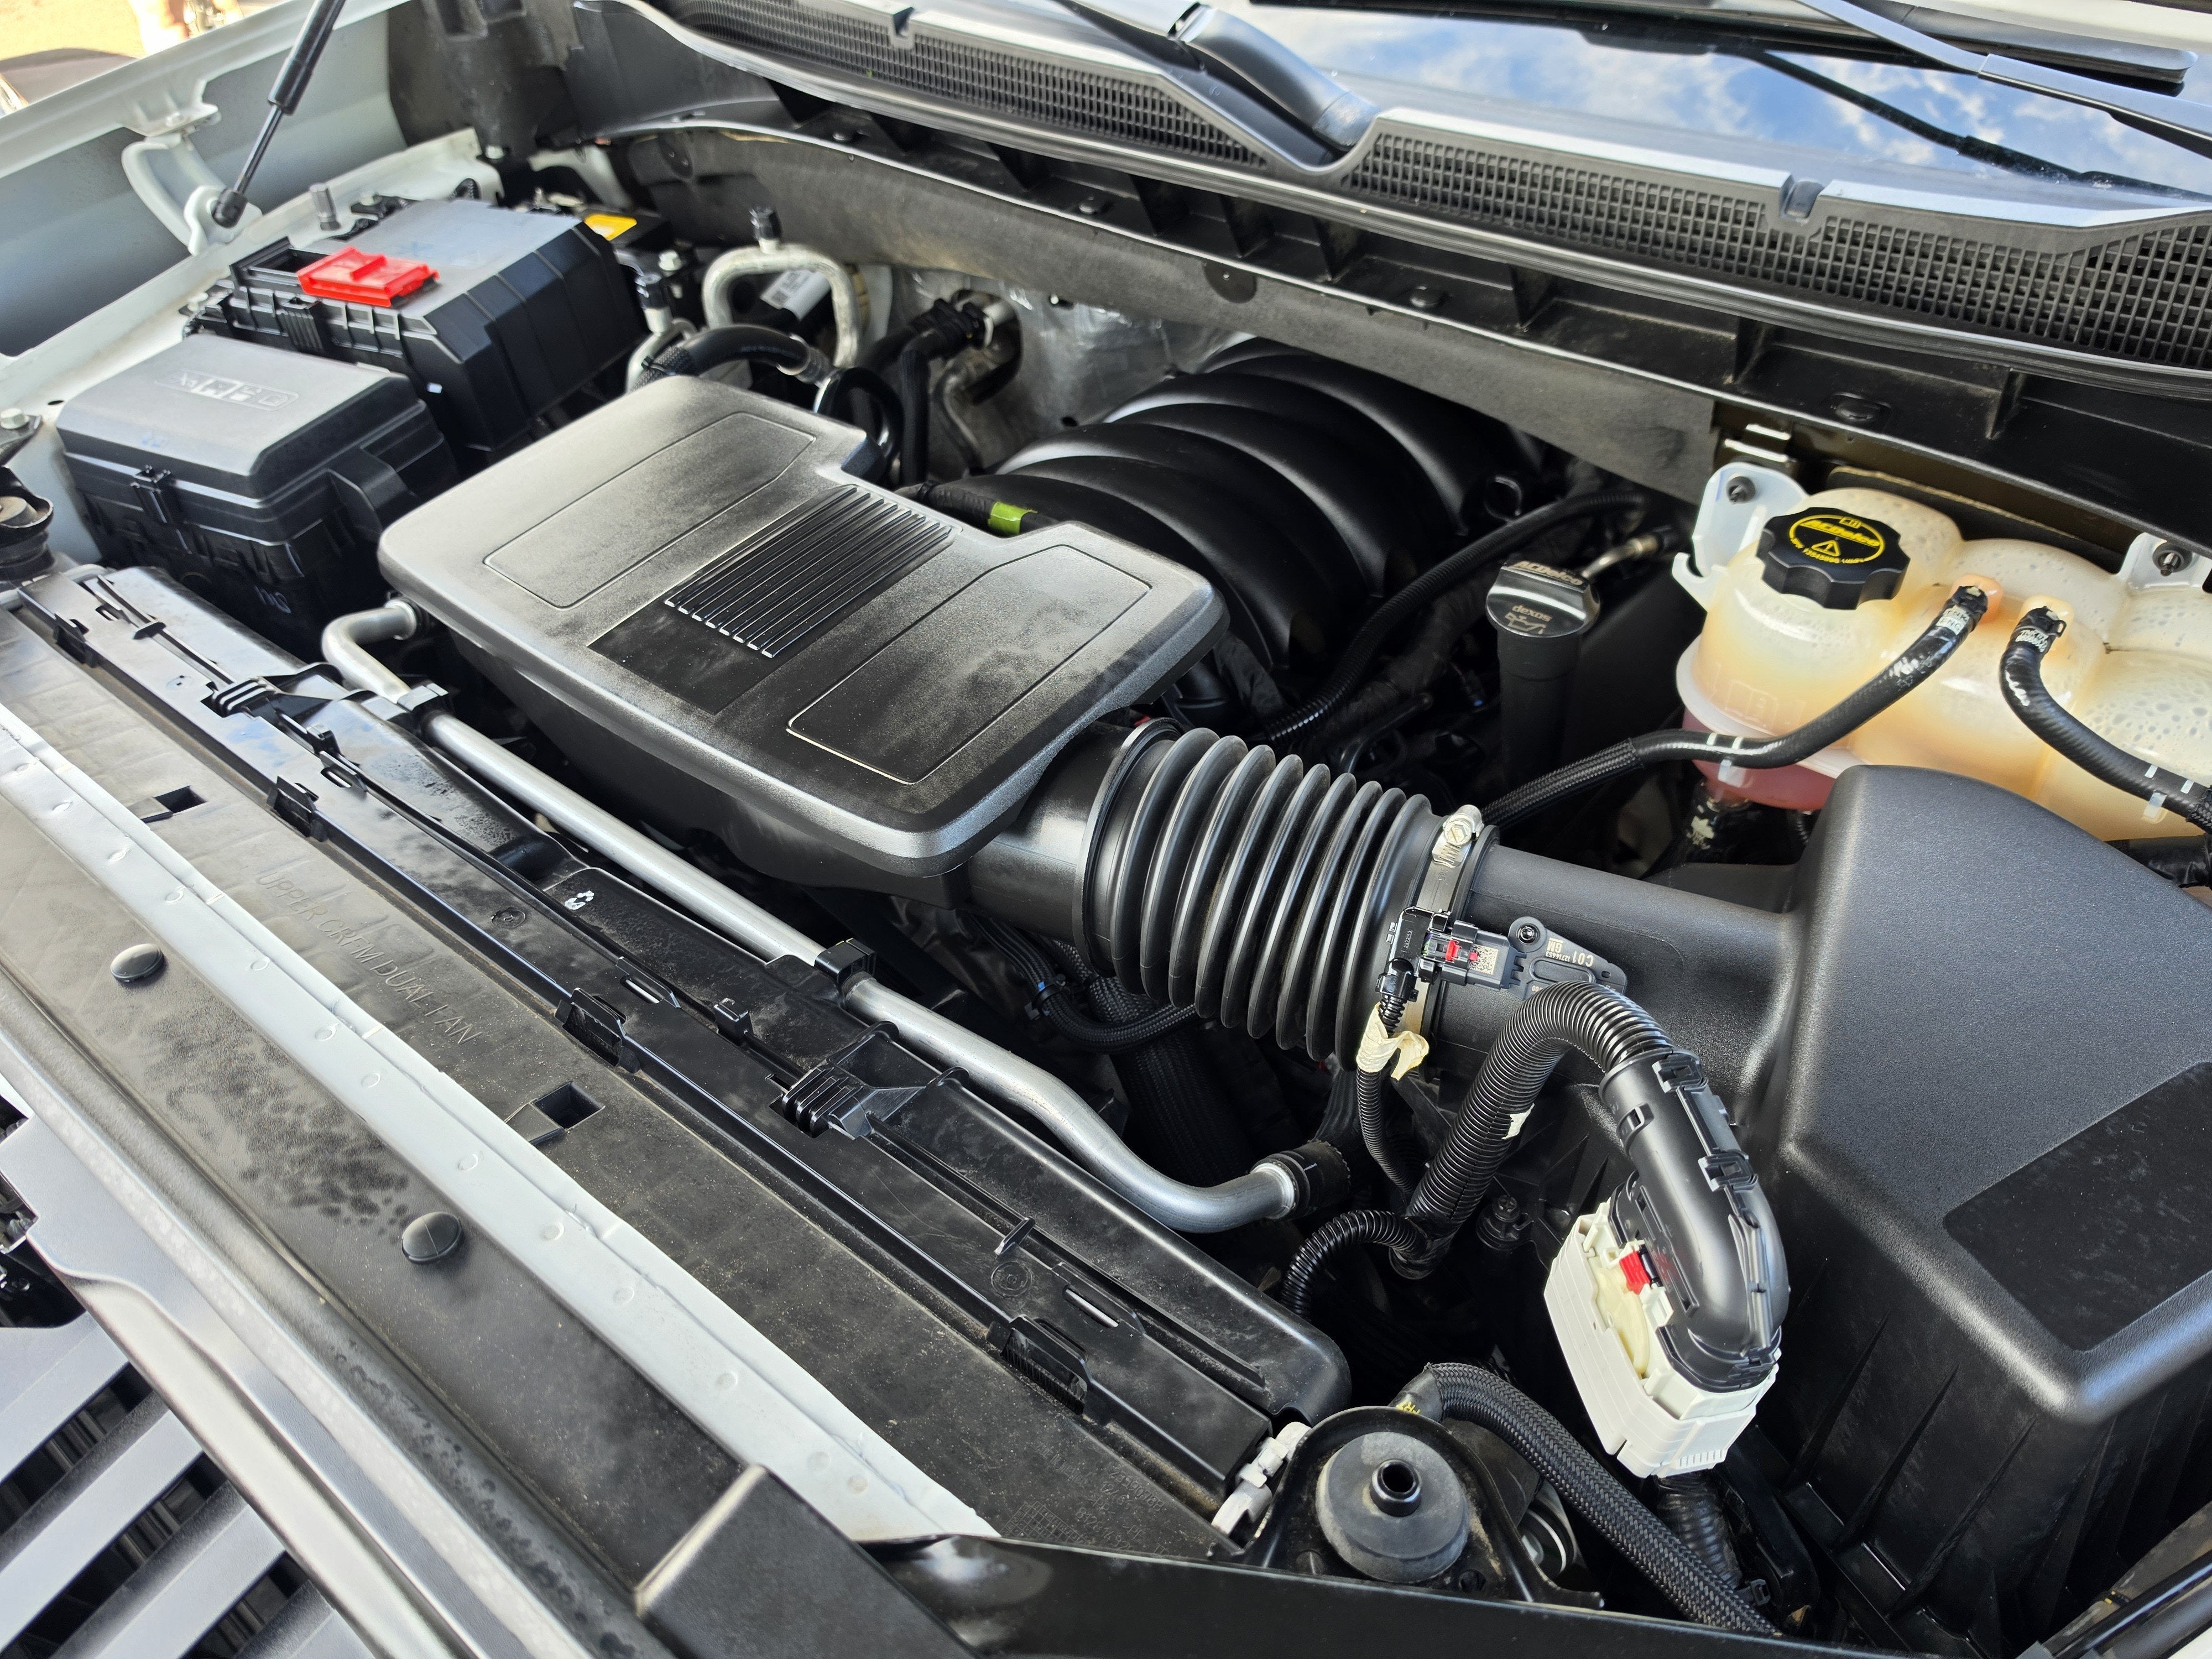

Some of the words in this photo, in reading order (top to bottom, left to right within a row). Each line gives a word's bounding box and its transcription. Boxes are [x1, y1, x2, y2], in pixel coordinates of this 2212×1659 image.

[1798, 519, 1880, 547] ACDelco
[1508, 560, 1583, 586] ACDelco
[1512, 604, 1552, 622] dexos
[257, 872, 328, 921] UPPER
[370, 959, 434, 1009] DUAL
[424, 1004, 483, 1044] FAN
[1547, 938, 1563, 953] GM
